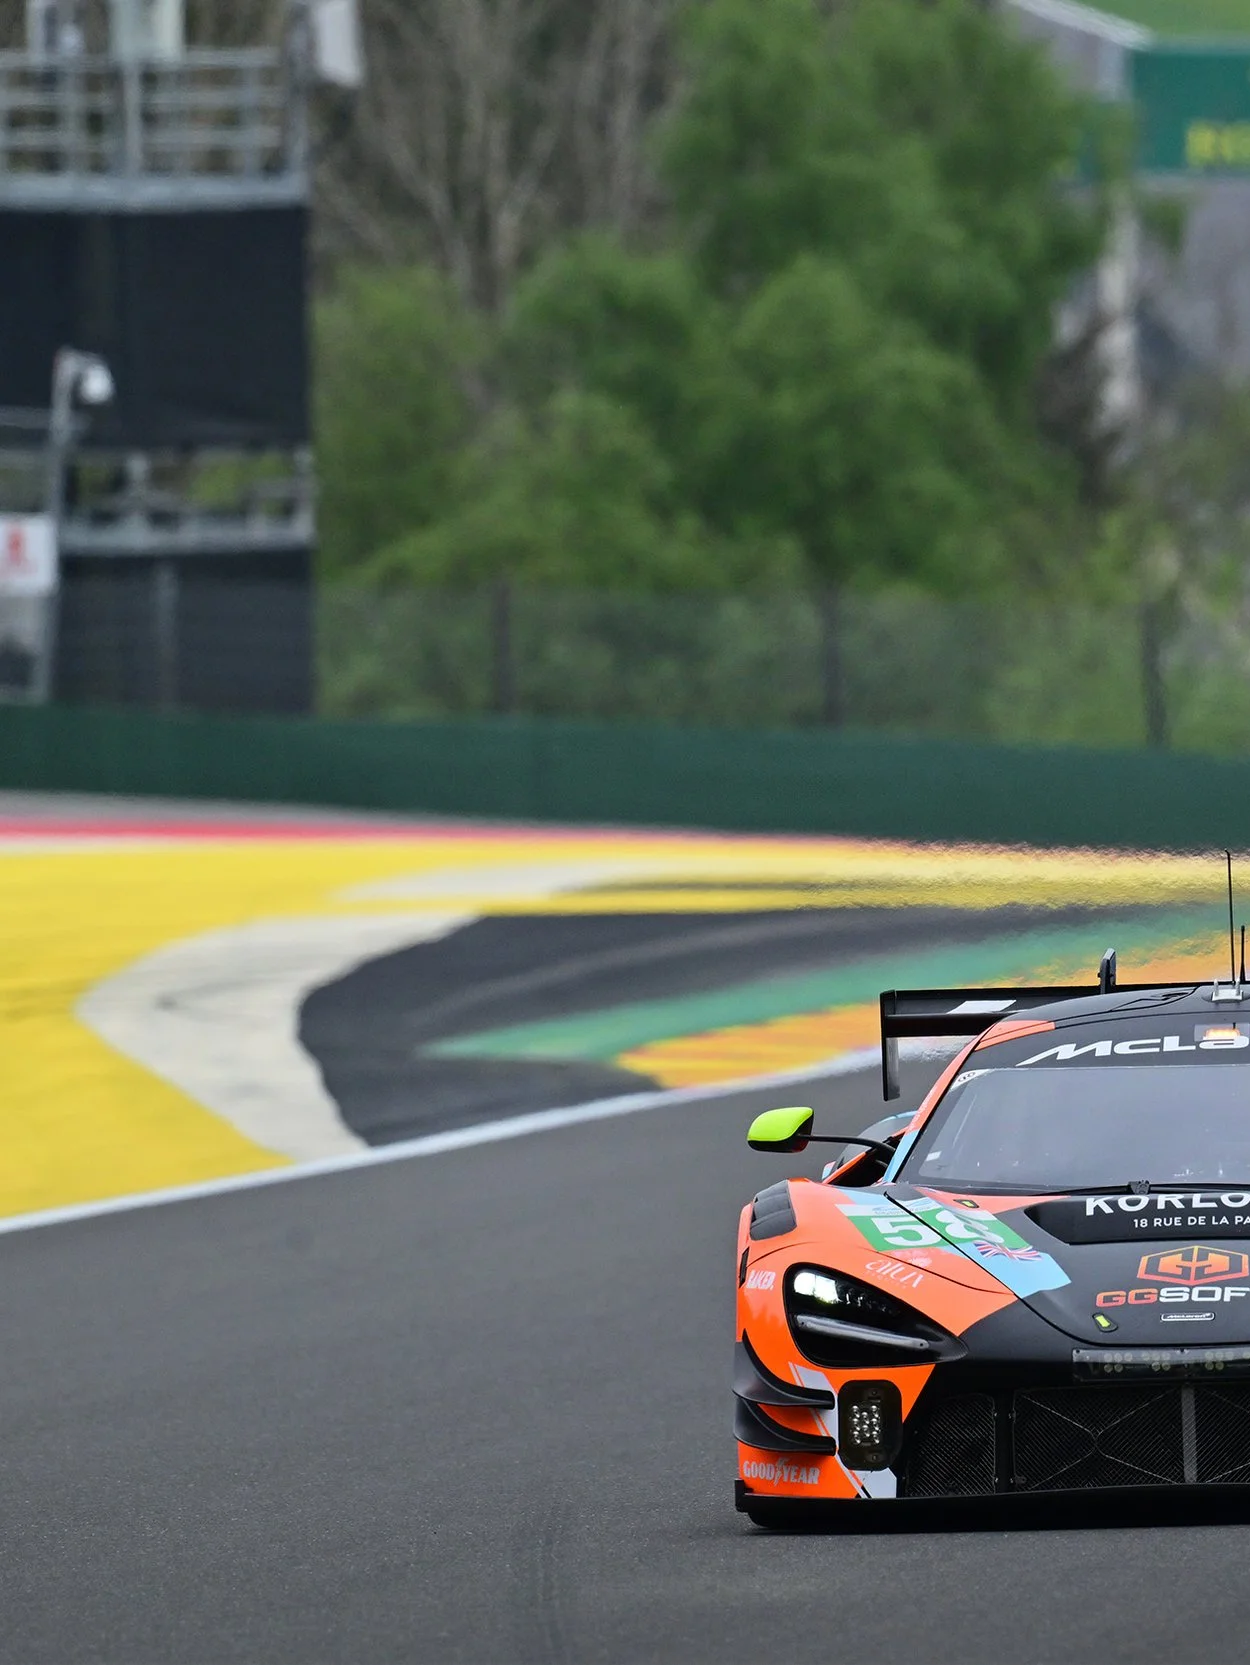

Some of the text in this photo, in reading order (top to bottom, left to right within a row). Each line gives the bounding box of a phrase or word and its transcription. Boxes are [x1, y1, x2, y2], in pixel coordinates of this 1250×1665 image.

[1134, 1218, 1148, 1228] 18
[1154, 1217, 1182, 1227] RUE
[1188, 1216, 1206, 1226] DE
[1212, 1216, 1229, 1225] LA
